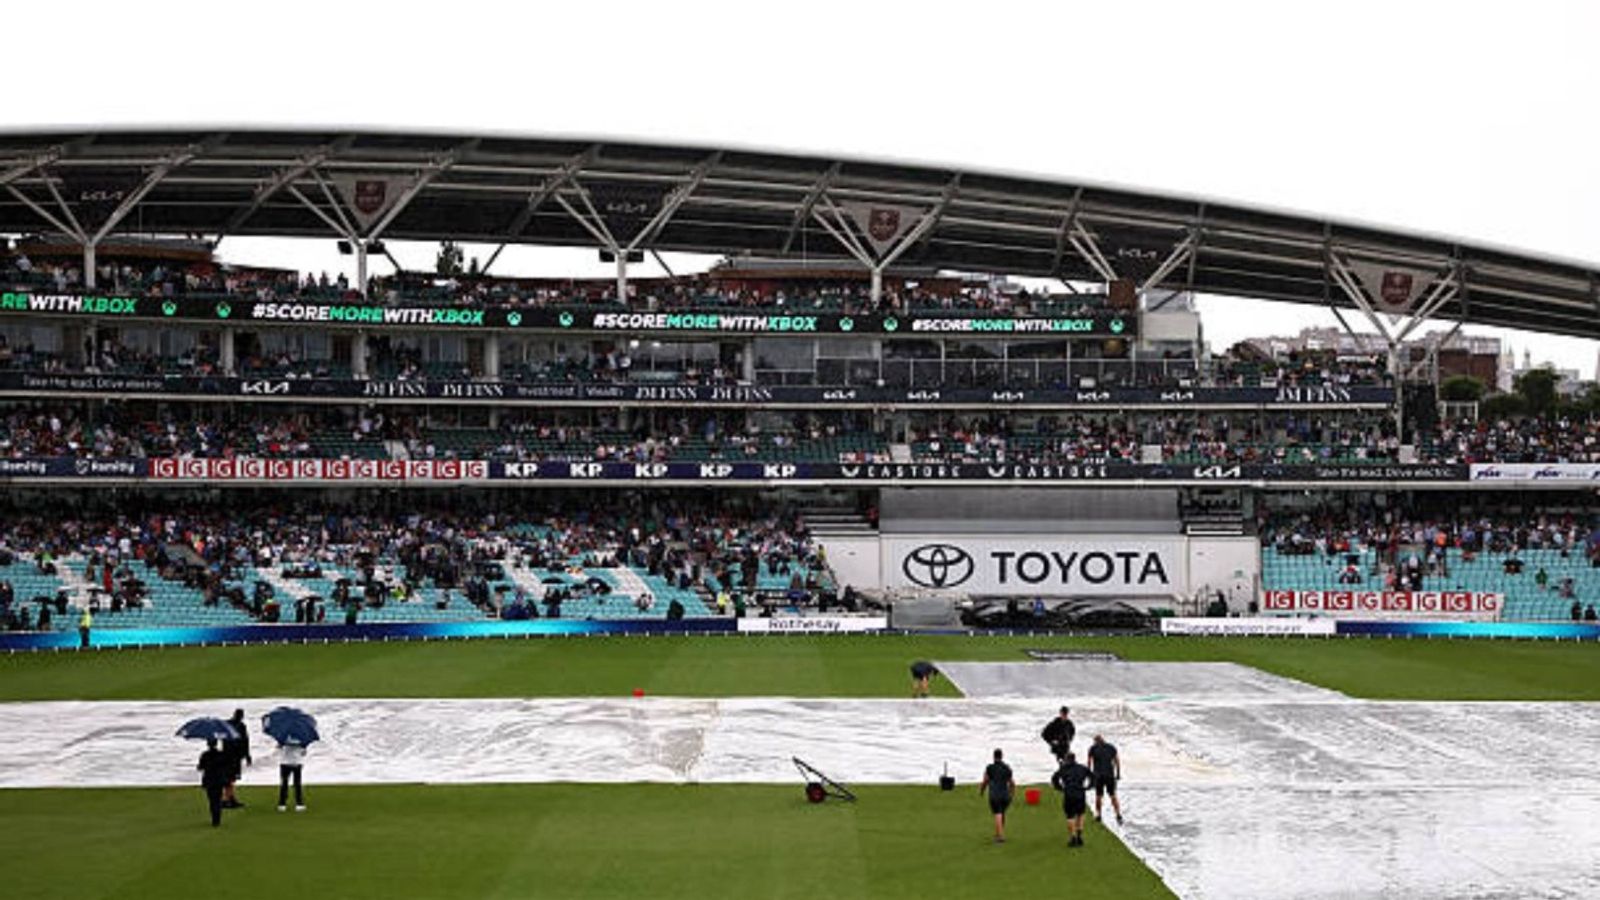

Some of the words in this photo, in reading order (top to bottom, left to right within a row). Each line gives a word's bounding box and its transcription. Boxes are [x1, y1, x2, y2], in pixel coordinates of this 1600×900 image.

[252, 303, 484, 325] #SCOREMOREWITHXBOX
[593, 313, 818, 332] #SCOREMOREWITHXBOX
[912, 319, 1094, 333] #SCOREMOREWITHXBOX
[241, 381, 290, 394] KIA
[389, 382, 426, 396] FINN
[465, 384, 503, 396] FINN
[660, 387, 697, 399] FINN
[735, 387, 773, 400] FINN
[1306, 387, 1351, 401] FINN
[154, 459, 174, 477] IG
[183, 459, 202, 477] IG
[212, 459, 232, 477] IG
[241, 459, 259, 477] IG
[269, 459, 289, 477] IG
[300, 459, 317, 477] IG
[326, 460, 346, 477] IG
[356, 460, 373, 477] IG
[382, 460, 401, 477] IG
[411, 460, 429, 477] IG
[437, 460, 456, 477] IG
[465, 460, 482, 477] IG
[505, 463, 538, 477] KP
[570, 463, 602, 477] KP
[635, 463, 667, 477] KP
[700, 463, 733, 477] KP
[763, 464, 796, 477] KP
[868, 466, 960, 478] CASTORE
[1014, 466, 1107, 478] CASTORE
[1194, 466, 1241, 477] KIA
[990, 551, 1169, 584] TOYOTA
[1270, 592, 1290, 608] IG
[1300, 592, 1318, 608] IG
[1328, 592, 1348, 608] IG
[1357, 592, 1377, 609] IG
[1386, 592, 1407, 609] IG
[1416, 593, 1437, 609] IG
[1446, 593, 1466, 609] IG
[1477, 593, 1497, 609] IG
[768, 619, 840, 632] Rothesay
